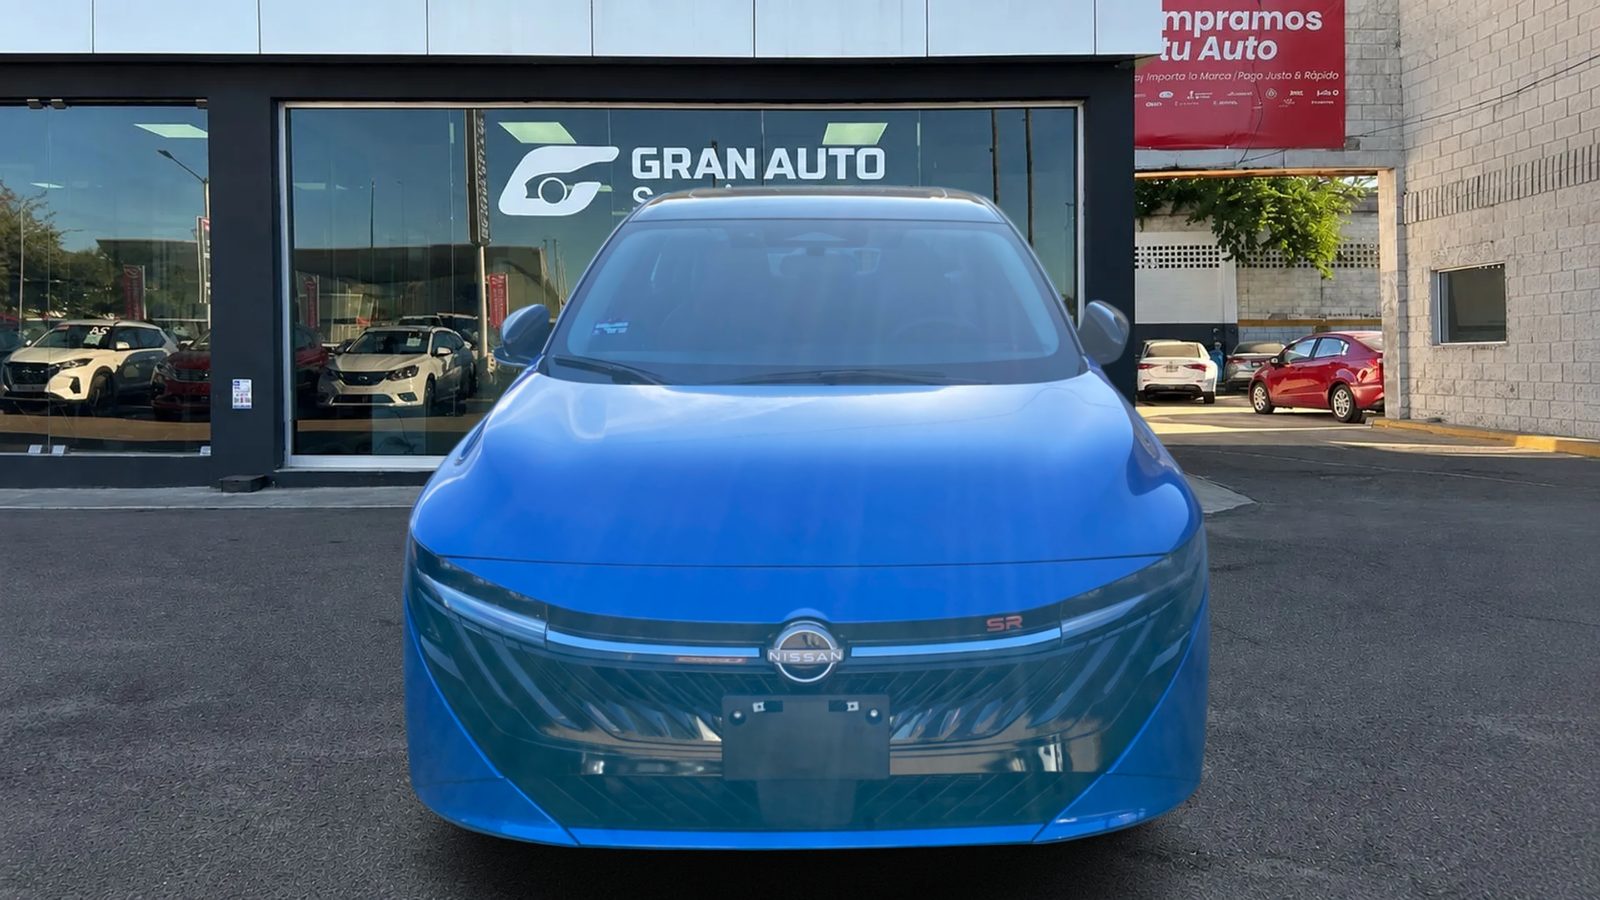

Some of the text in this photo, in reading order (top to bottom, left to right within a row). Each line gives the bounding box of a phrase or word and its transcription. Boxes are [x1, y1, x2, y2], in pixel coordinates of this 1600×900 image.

[1162, 10, 1323, 38] mpramos
[1160, 36, 1278, 61] tu Auto
[1146, 72, 1186, 83] Importa
[1200, 72, 1232, 81] Marca
[1265, 71, 1292, 81] Justo
[631, 147, 886, 180] GRAN AUTO
[986, 615, 1023, 632] SR
[768, 651, 843, 663] NISSAN
